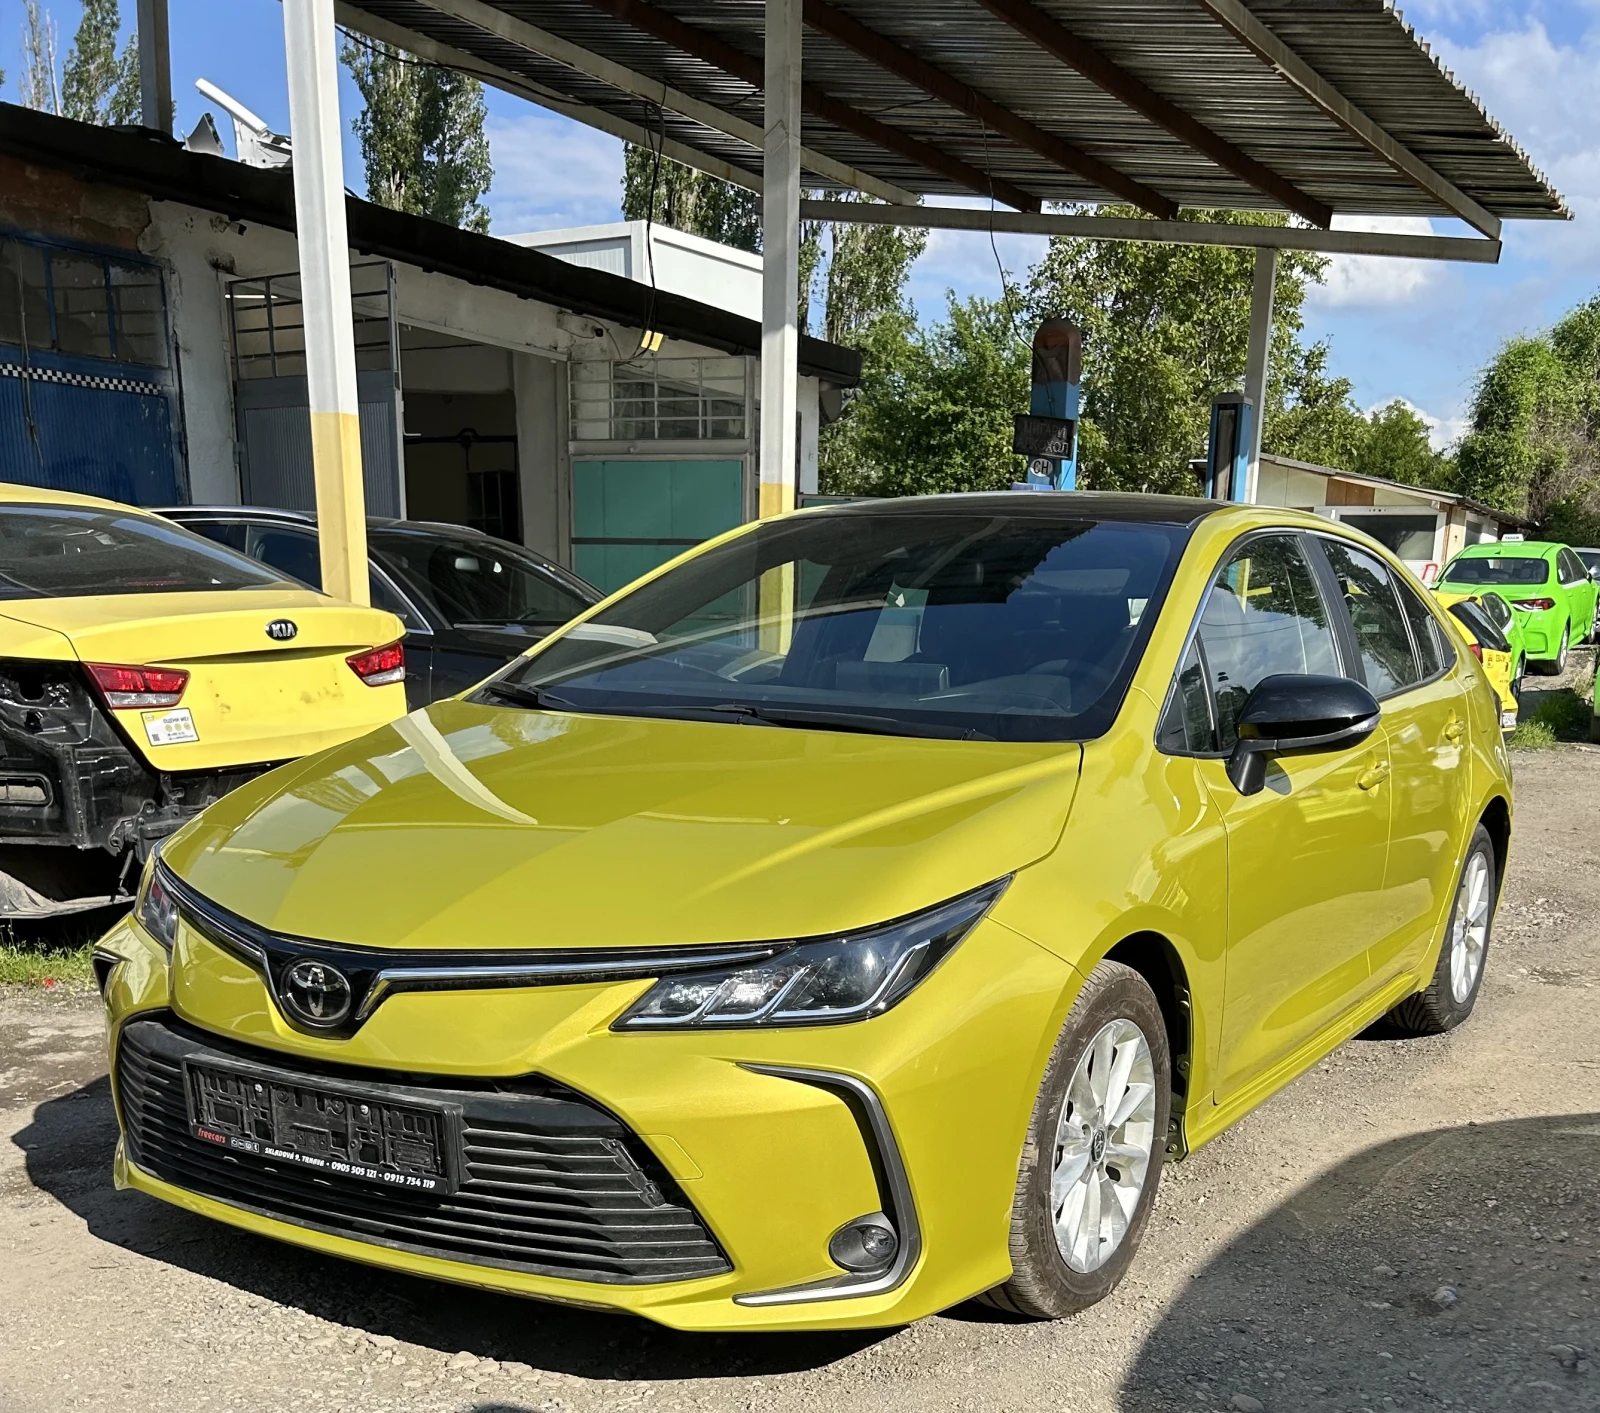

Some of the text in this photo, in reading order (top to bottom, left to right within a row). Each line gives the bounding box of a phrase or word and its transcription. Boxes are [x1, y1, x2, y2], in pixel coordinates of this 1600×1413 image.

[1033, 460, 1049, 475] CH
[271, 623, 295, 637] KIA
[198, 1127, 226, 1144] freecars
[264, 1147, 295, 1160] SKLADOVÁ
[301, 1155, 325, 1167] TRNAVA
[331, 1161, 350, 1173] 0905
[350, 1165, 366, 1176] 505
[366, 1168, 377, 1179] 121
[383, 1172, 405, 1184] 0915
[406, 1176, 421, 1187] 754
[422, 1179, 436, 1189] 119
